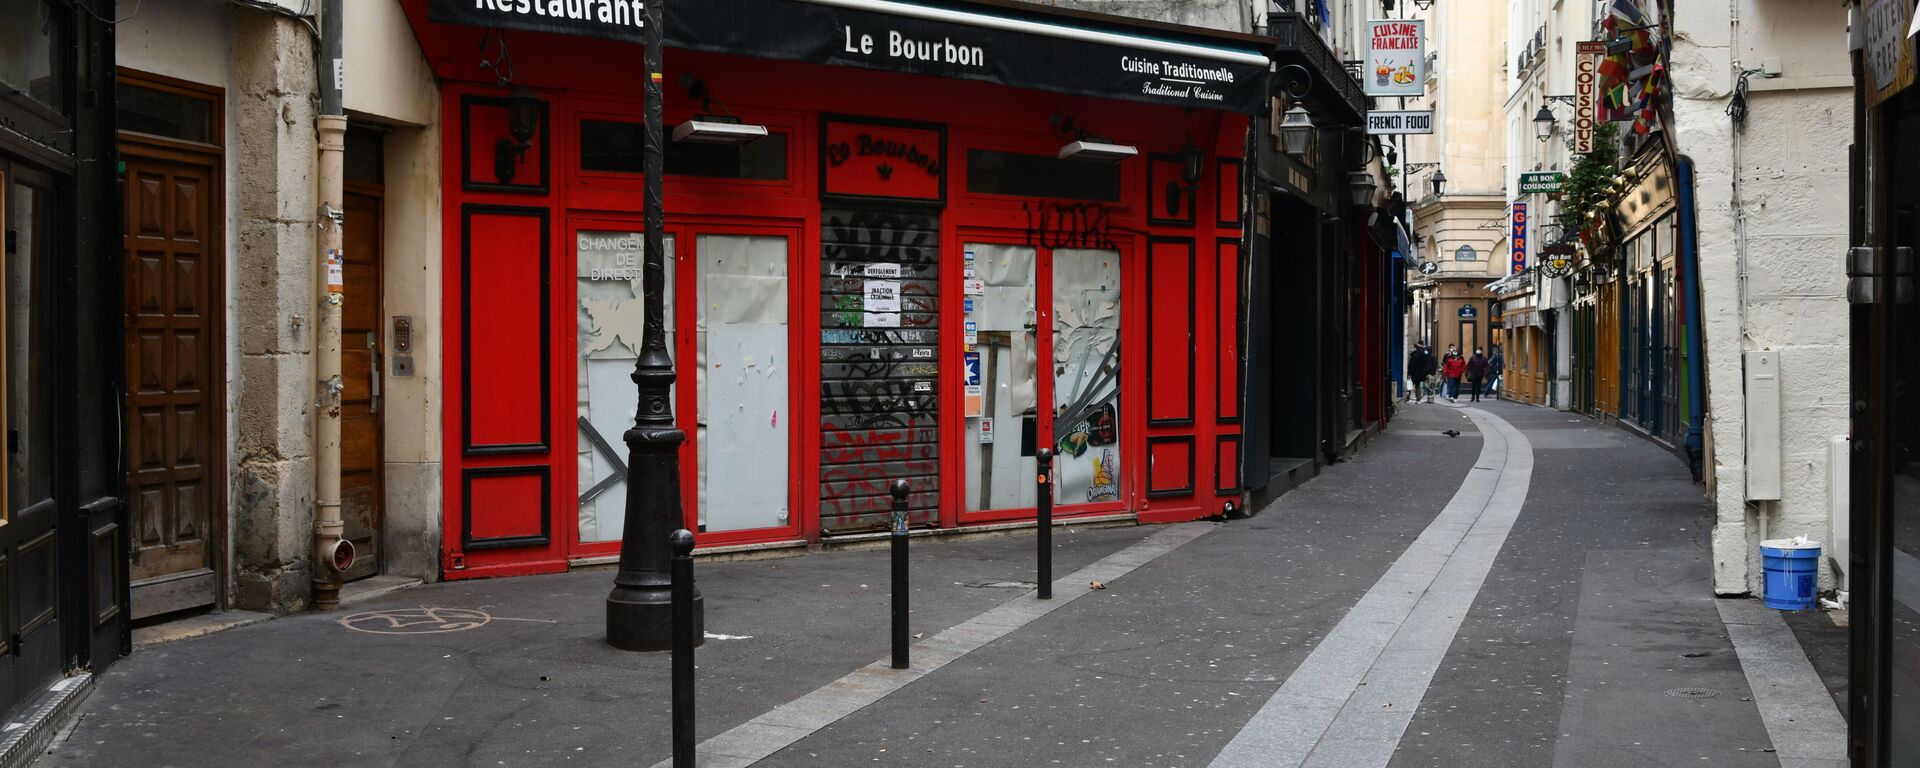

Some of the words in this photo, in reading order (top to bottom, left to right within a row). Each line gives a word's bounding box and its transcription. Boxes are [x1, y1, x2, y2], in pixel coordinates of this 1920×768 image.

[1373, 23, 1417, 37] CUISINE
[845, 25, 874, 55] Le
[889, 30, 984, 67] Bourbon
[1121, 56, 1160, 75] Cuisine
[1162, 61, 1234, 83] Traditionnelle
[1142, 81, 1190, 98] Traditional
[1193, 86, 1223, 101] Cuisine
[1576, 61, 1593, 152] COUSCOUS
[829, 142, 850, 168] Le
[579, 238, 674, 251] CHANGEMT
[1513, 212, 1526, 273] GYROS
[616, 253, 634, 265] DE
